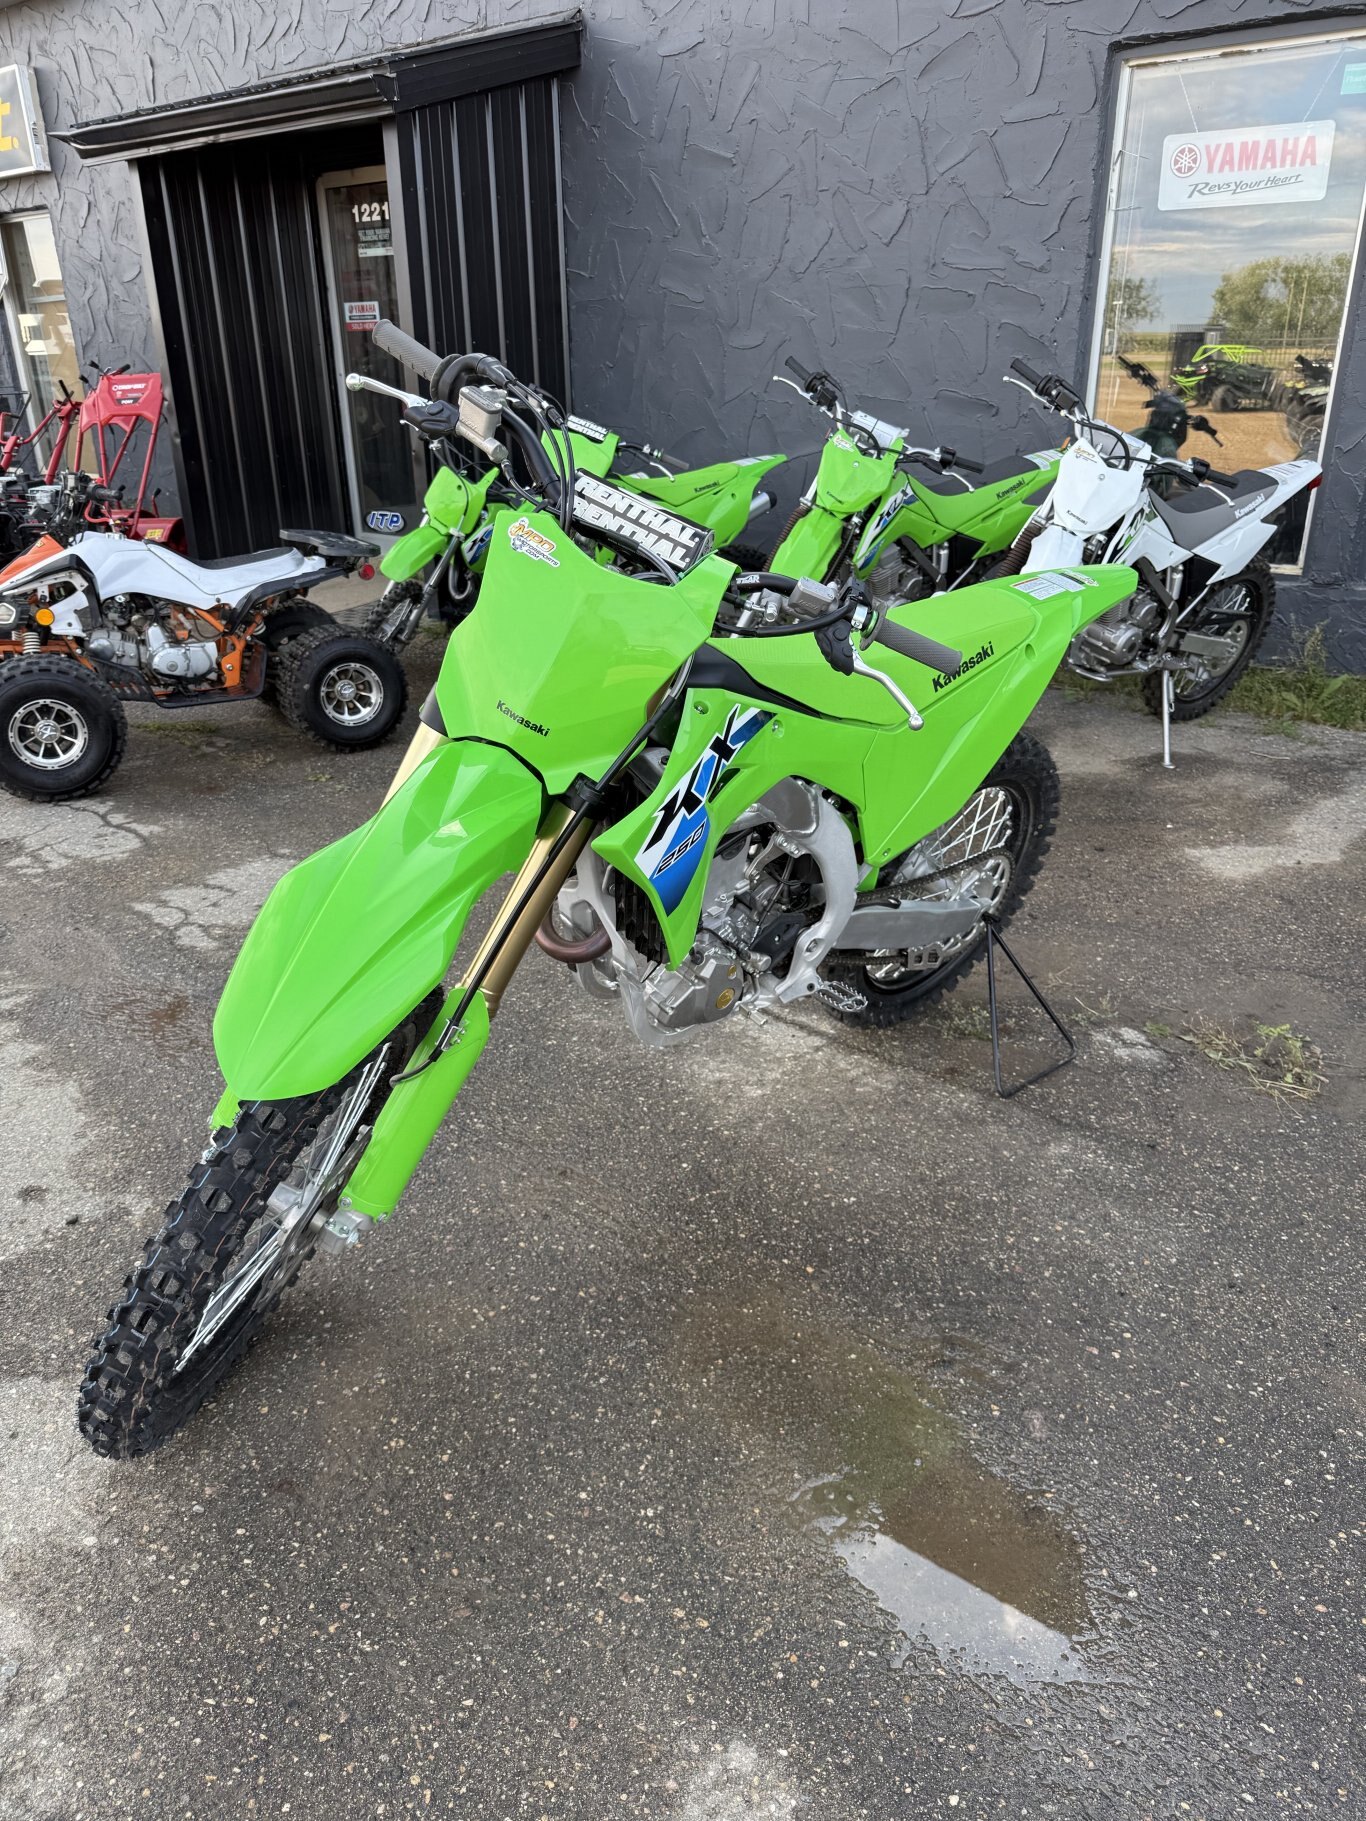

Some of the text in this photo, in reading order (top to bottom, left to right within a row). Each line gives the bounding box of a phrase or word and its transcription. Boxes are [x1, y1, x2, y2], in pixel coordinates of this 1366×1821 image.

[1205, 135, 1317, 173] YAMAHA
[1187, 173, 1302, 198] Revs Your Heart
[352, 201, 390, 223] 1221
[354, 303, 377, 314] YAMAHA
[996, 477, 1026, 501] Kawasaki
[369, 511, 402, 530] ITP
[574, 476, 697, 548] RENTHAL
[1066, 509, 1088, 526] Kawasaki
[1233, 492, 1266, 519] Kawasaki
[572, 495, 689, 569] RENTHAL
[931, 640, 995, 693] Kawasaki
[496, 699, 551, 737] Kawasaki
[641, 702, 742, 856] KX
[652, 815, 709, 879] 250
